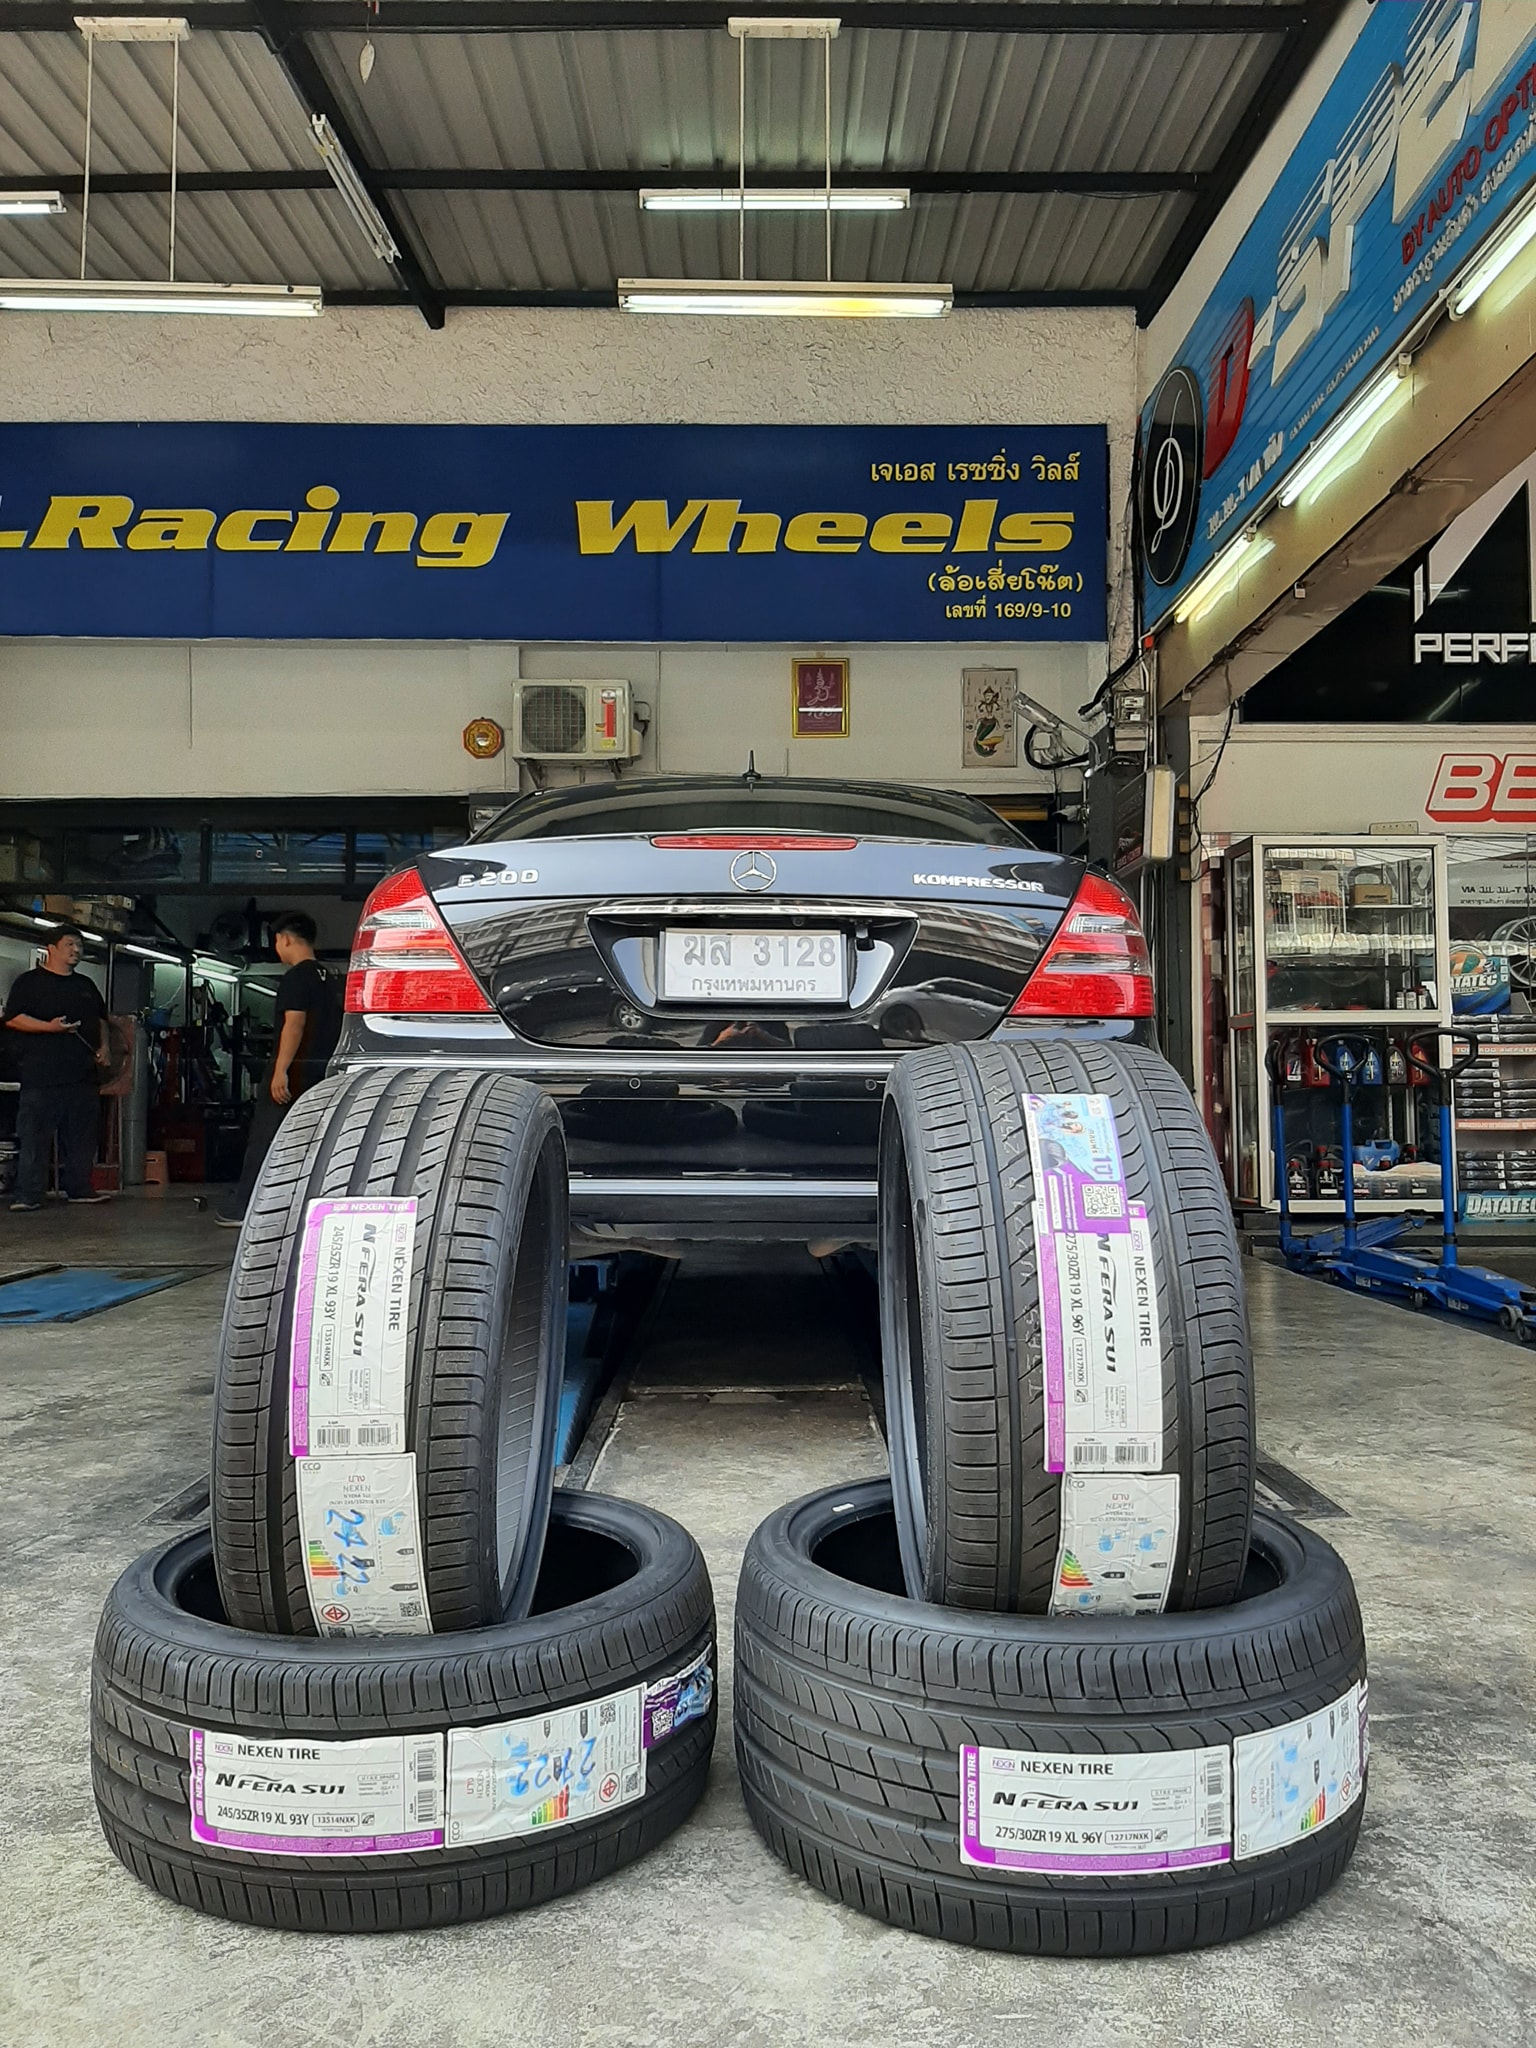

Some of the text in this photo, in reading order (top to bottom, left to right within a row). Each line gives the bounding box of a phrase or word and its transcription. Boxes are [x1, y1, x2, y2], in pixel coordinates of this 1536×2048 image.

[1402, 214, 1426, 264] BY
[870, 447, 1081, 482] เจเอส เรซซิ่ง วิลส์
[574, 499, 1075, 554] Wheels
[945, 595, 1072, 619] เลขที่ 169/9-10
[458, 868, 539, 888] E 200
[912, 873, 1045, 893] KOMPRESSOR
[753, 935, 836, 967] 3128
[691, 977, 817, 996] กรุงเทพมหานคร
[1450, 973, 1498, 987] TATEC
[350, 1203, 385, 1211] NEXEN
[325, 1284, 338, 1299] XL
[388, 1247, 408, 1332] NEXEN TIRE
[324, 1300, 336, 1320] 93Y
[1070, 1298, 1083, 1311] XL
[1133, 1256, 1152, 1347] NEXEN TIRE
[1072, 1314, 1085, 1336] 96Y
[195, 1737, 203, 1760] TIRE
[237, 1744, 321, 1760] NEXEN TIRE
[967, 1752, 976, 1777] TIRE
[1020, 1760, 1114, 1776] NEXEN TIRE
[196, 1762, 204, 1799] NEXEN
[215, 1773, 236, 1787] N
[967, 1778, 977, 1818] NEXEN
[993, 1792, 1016, 1805] N
[217, 1805, 259, 1821] 245/35ZR
[261, 1811, 272, 1823] 19
[275, 1812, 287, 1824] XL
[289, 1813, 309, 1825] 93Y
[317, 1816, 356, 1824] 13514NXK
[995, 1825, 1103, 1844] 275/30ZR 19 XL 96Y
[1109, 1831, 1150, 1842] 12717NXK
